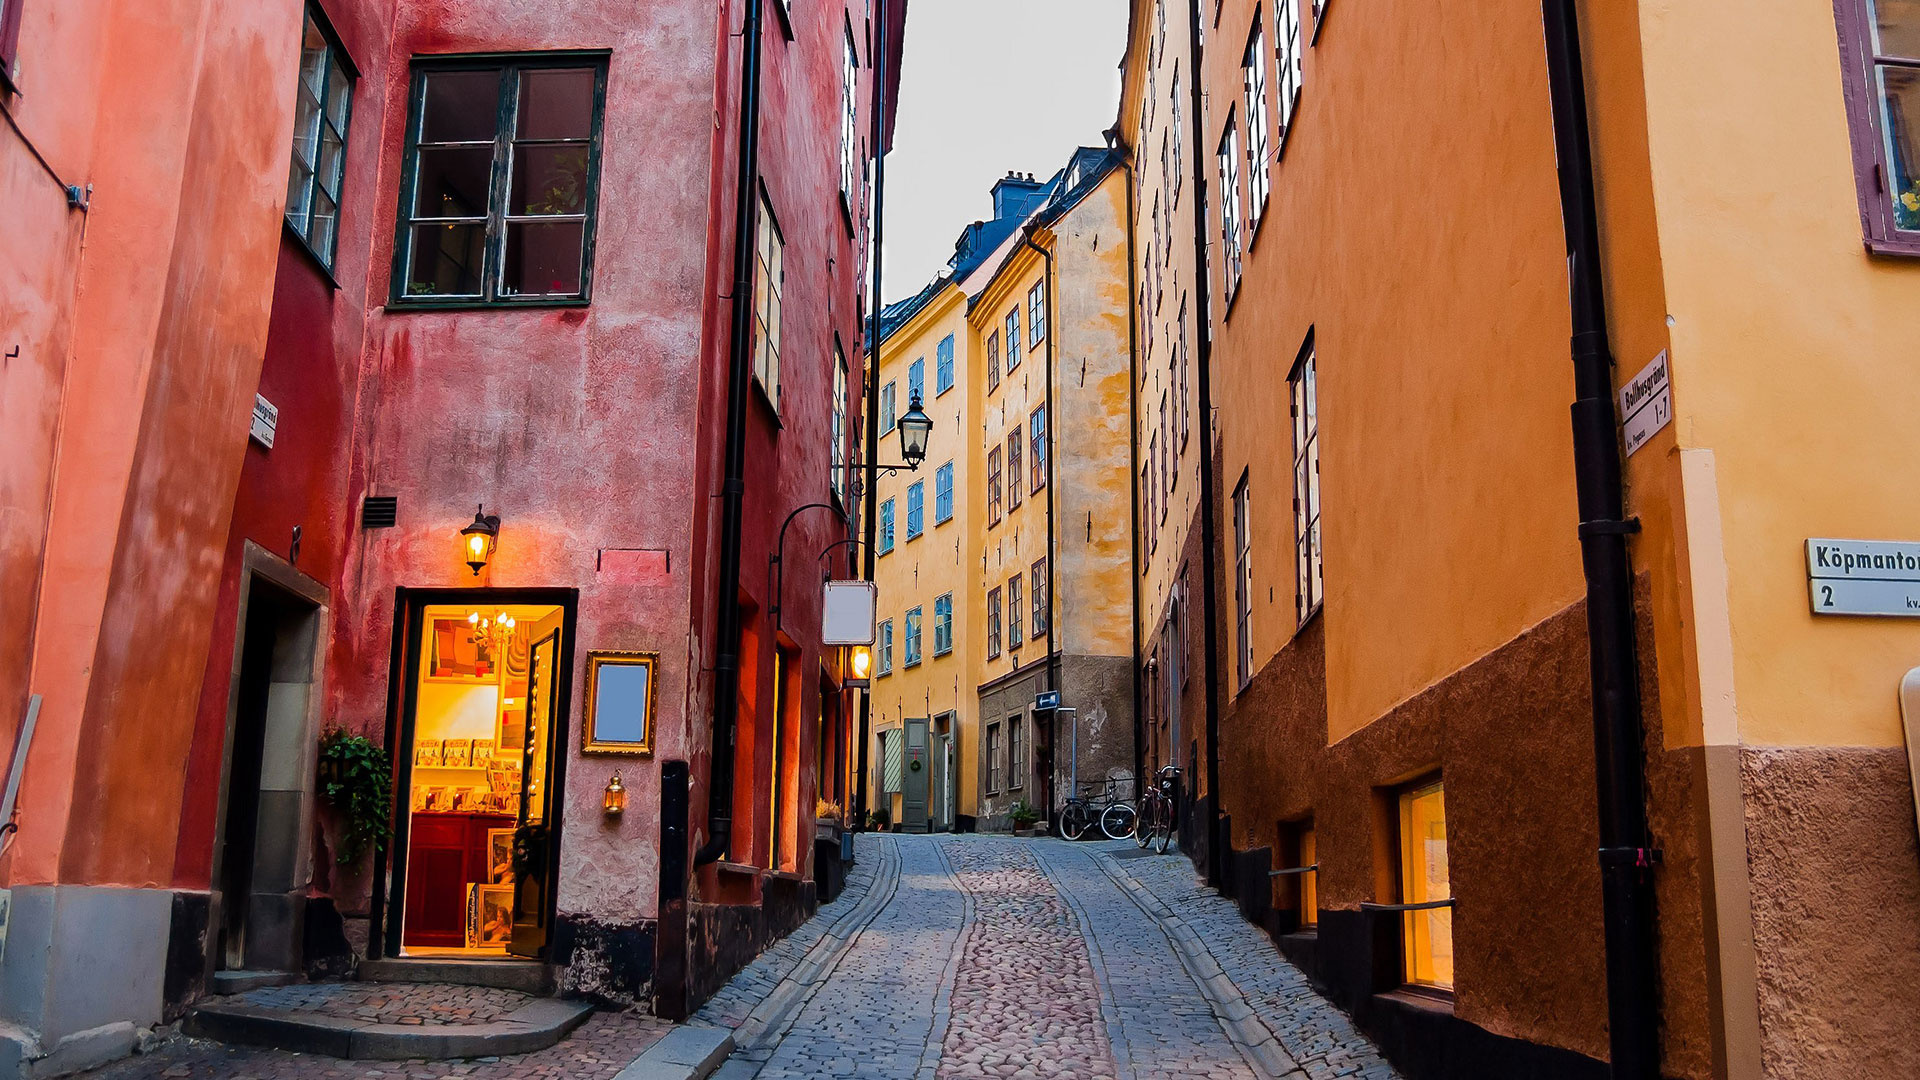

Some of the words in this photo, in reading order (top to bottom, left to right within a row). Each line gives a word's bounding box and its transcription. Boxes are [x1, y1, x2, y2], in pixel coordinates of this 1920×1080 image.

[1624, 356, 1665, 411] Bollhusgränd
[1654, 396, 1667, 424] 1-7
[1821, 585, 1834, 606] 2
